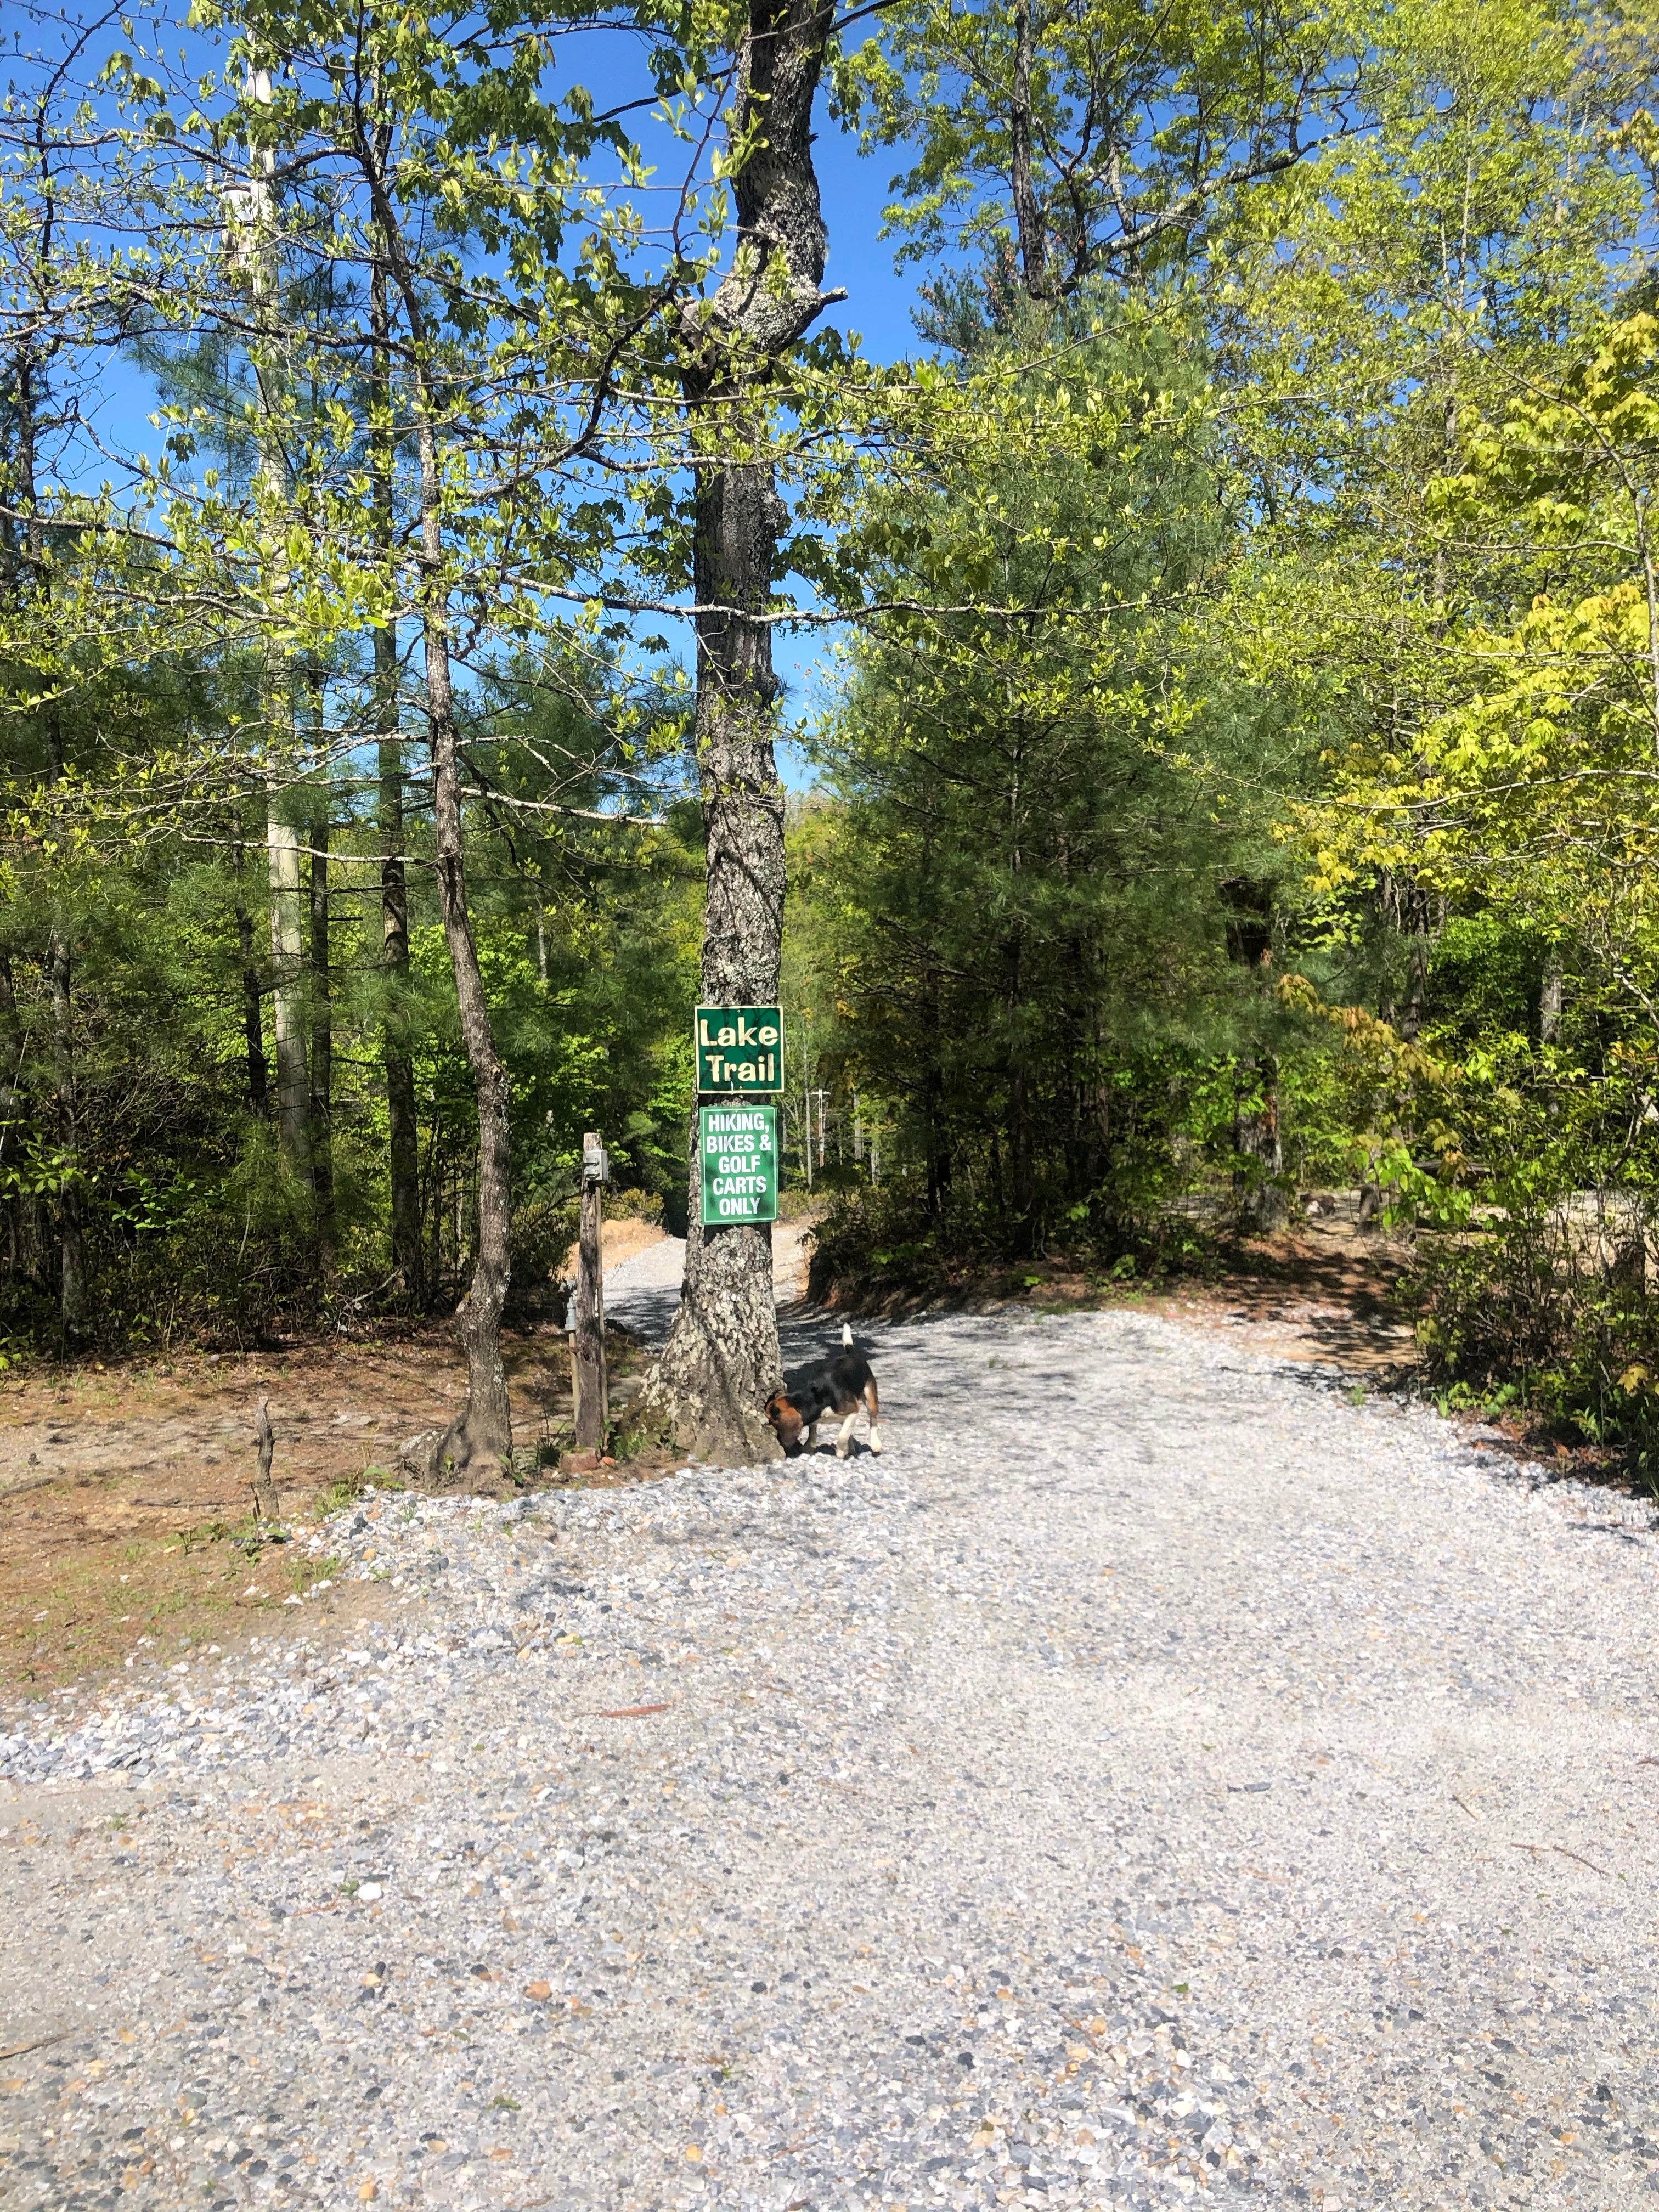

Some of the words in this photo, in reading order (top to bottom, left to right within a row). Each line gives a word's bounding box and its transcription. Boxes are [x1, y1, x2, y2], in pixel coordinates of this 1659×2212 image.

[700, 1017, 778, 1046] Lake
[705, 1053, 774, 1082] Trail
[708, 1113, 769, 1133] HIKING,
[707, 1134, 755, 1153] BIKES
[759, 1134, 772, 1151] &
[719, 1155, 760, 1173] GOLF
[713, 1176, 766, 1195] CARTS
[719, 1197, 760, 1216] ONLY
